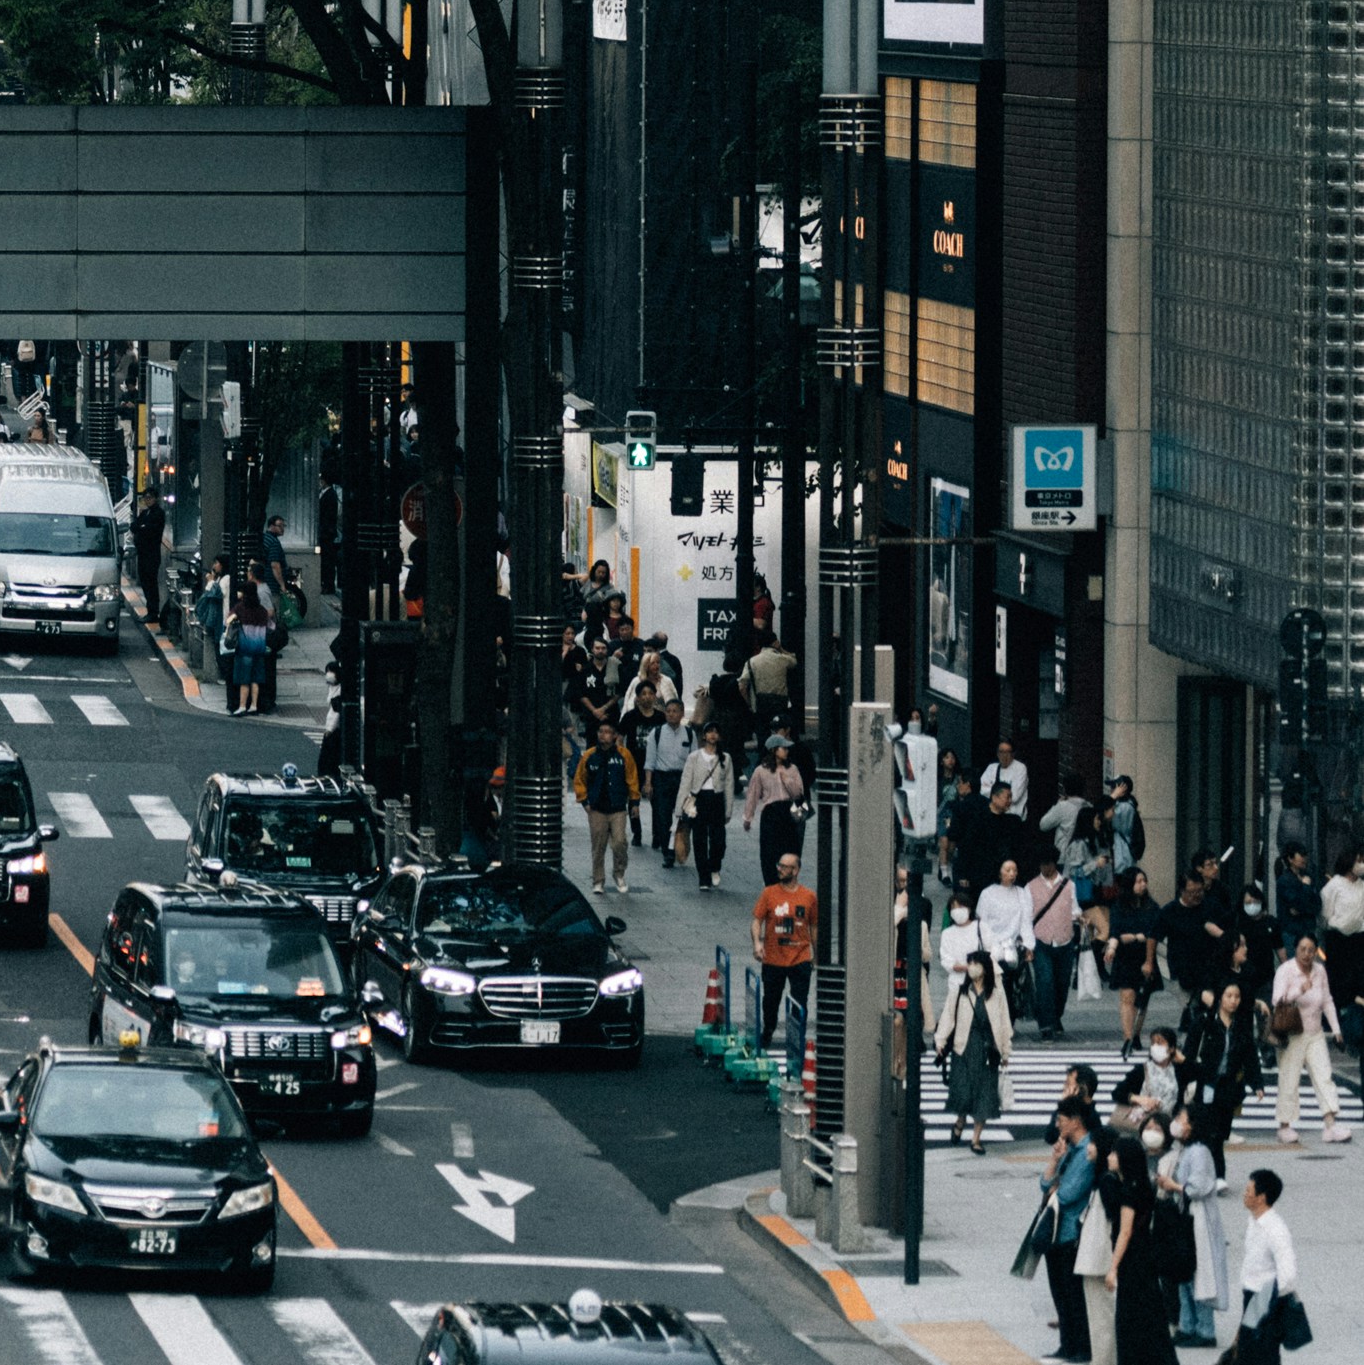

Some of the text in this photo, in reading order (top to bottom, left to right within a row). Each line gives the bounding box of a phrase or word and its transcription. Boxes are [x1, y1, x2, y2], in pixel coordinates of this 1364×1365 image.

[933, 229, 963, 258] COACH
[887, 457, 908, 482] COACH
[138, 1239, 176, 1252] 82-73
